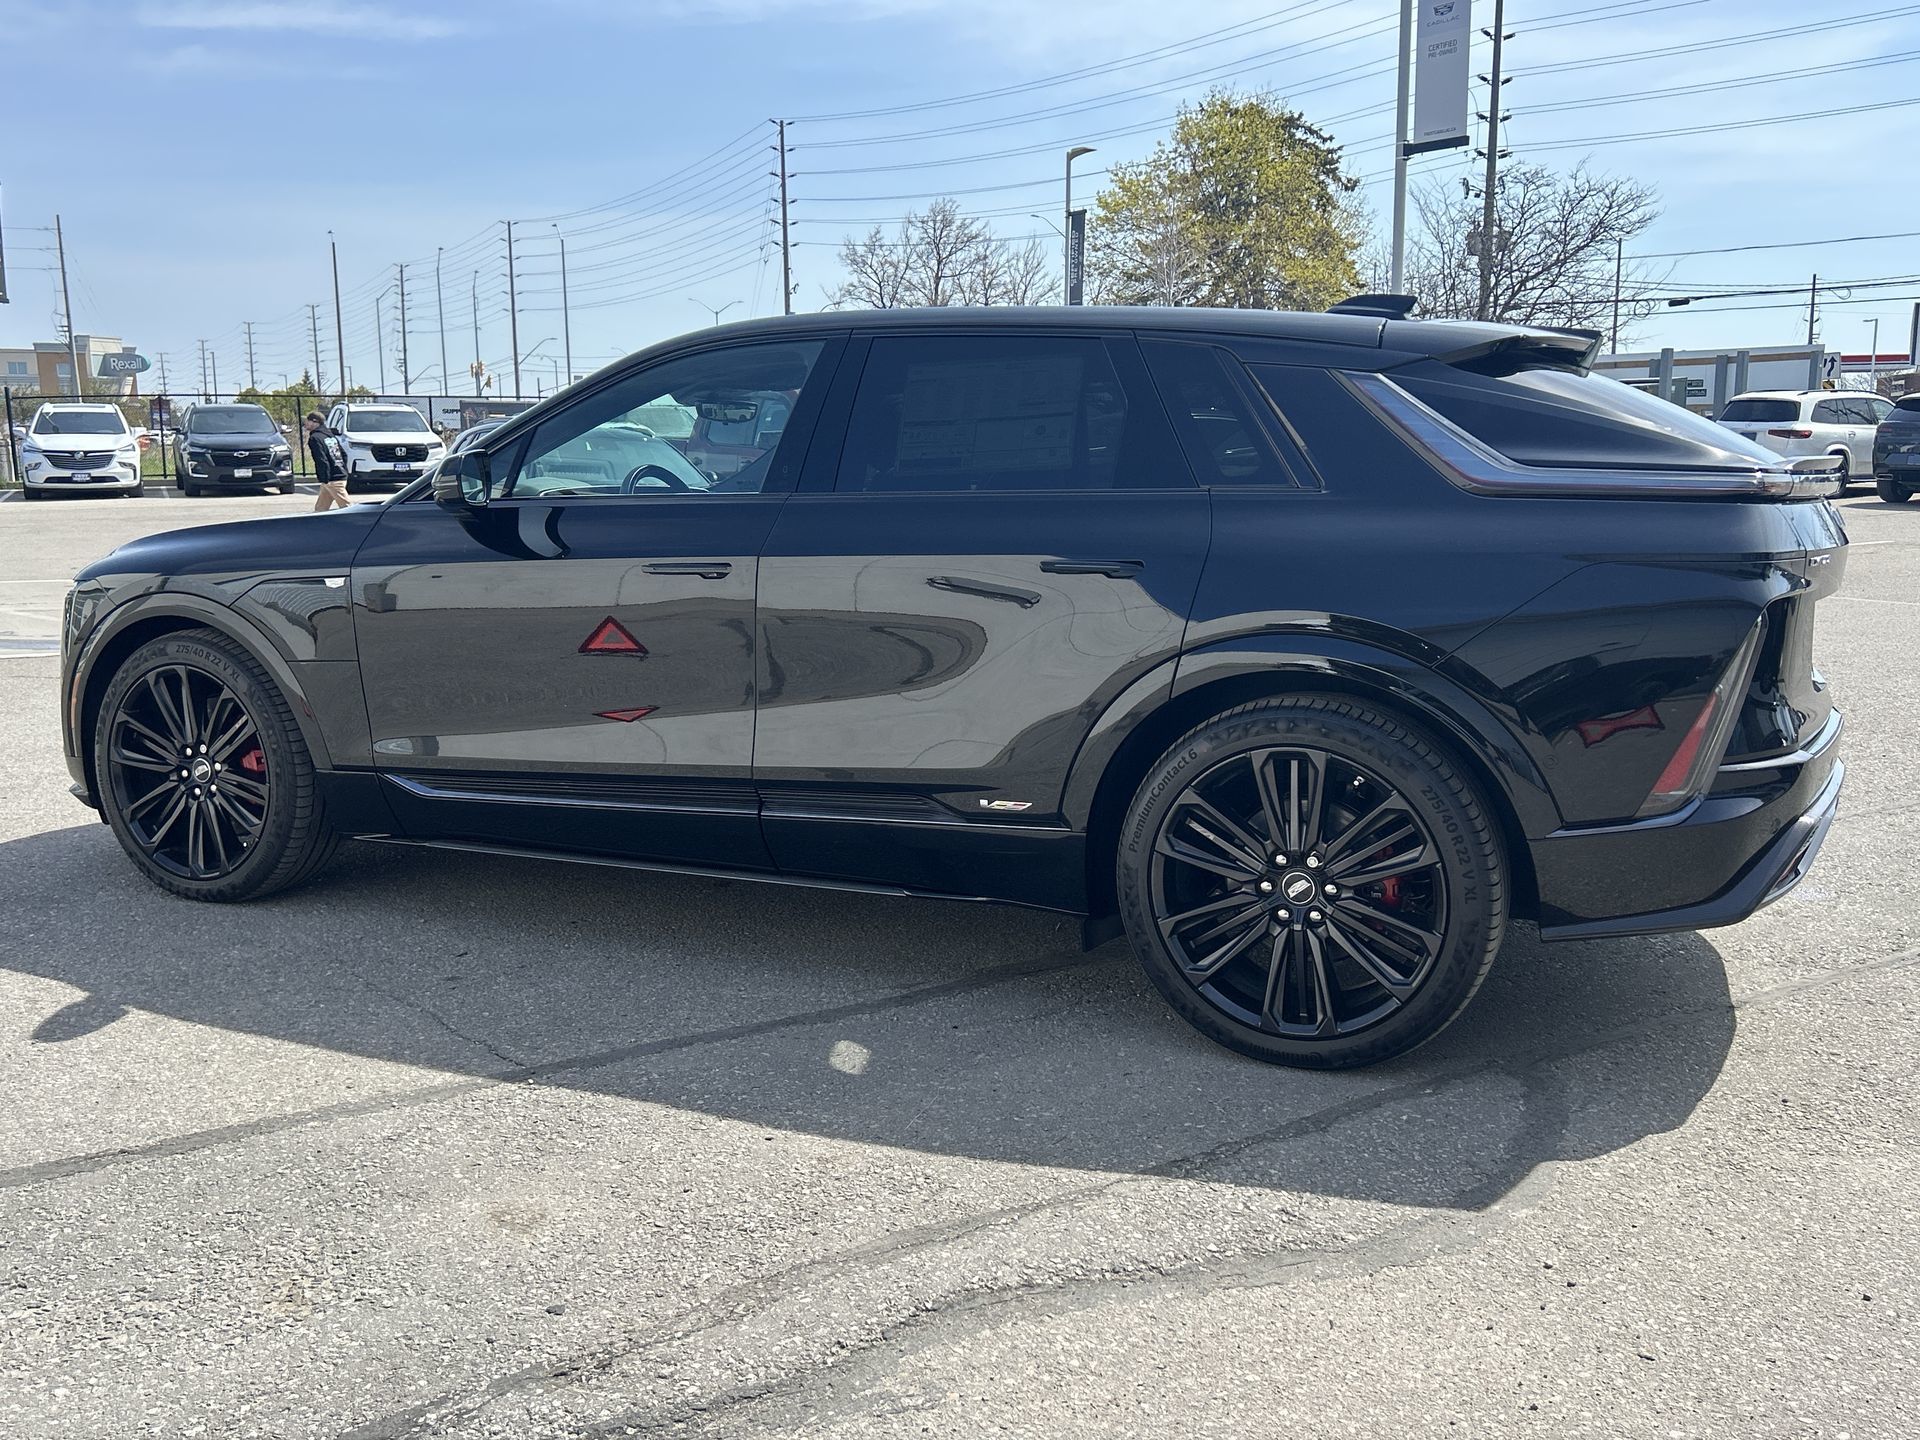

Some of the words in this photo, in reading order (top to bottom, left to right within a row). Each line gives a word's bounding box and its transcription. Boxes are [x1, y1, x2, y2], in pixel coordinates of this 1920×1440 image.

[1427, 14, 1460, 27] CADILLAC
[1428, 39, 1458, 52] CERTIFIED
[1428, 46, 1458, 58] PRE-OWNED
[110, 357, 142, 371] Rexall
[175, 644, 204, 657] 275/40
[223, 661, 230, 671] V
[230, 669, 241, 683] XL
[1128, 755, 1190, 853] PremiumContact
[1188, 748, 1198, 760] 6
[1421, 785, 1459, 834] 275/40
[1462, 869, 1476, 880] V
[1464, 886, 1478, 904] XL
